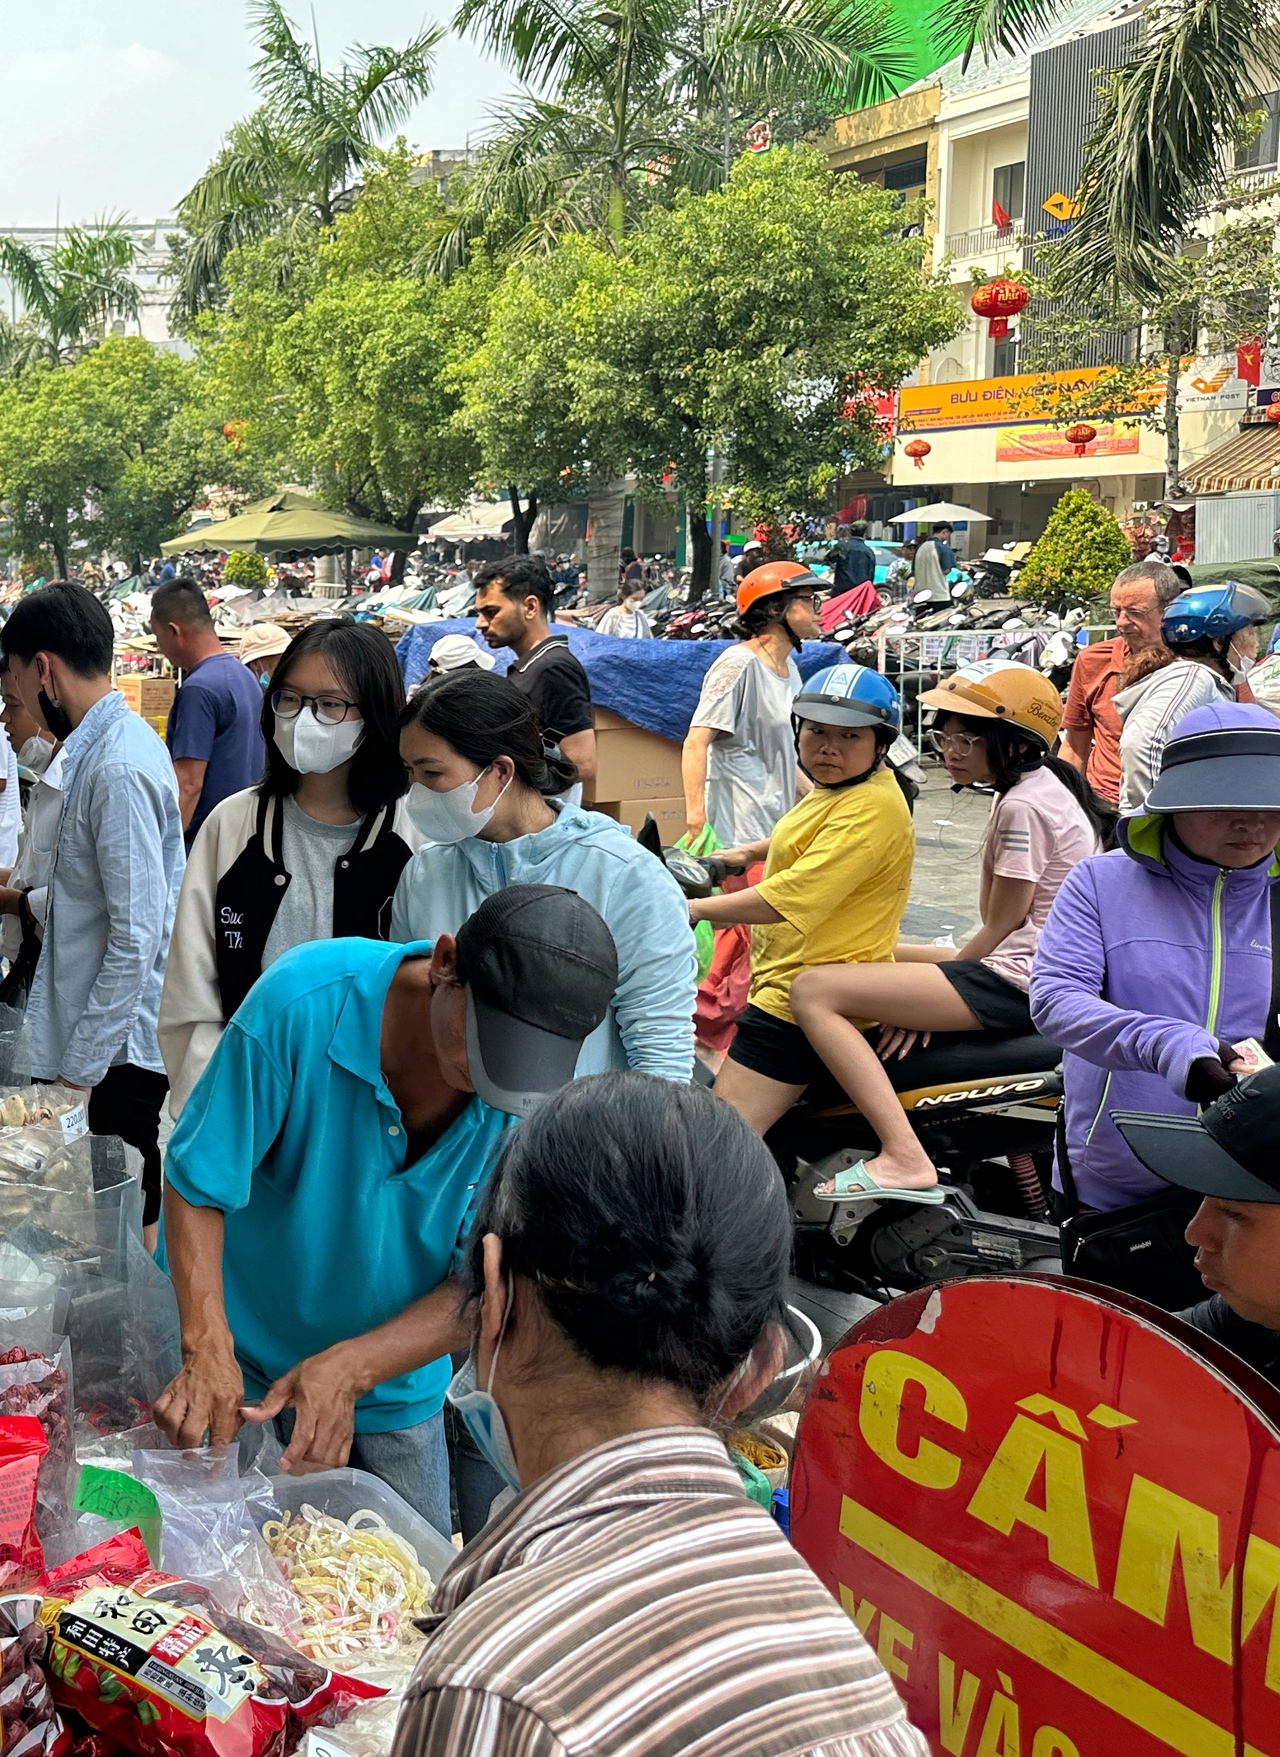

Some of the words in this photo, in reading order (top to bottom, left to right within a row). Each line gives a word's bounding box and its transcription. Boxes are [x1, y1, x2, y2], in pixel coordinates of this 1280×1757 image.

[982, 385, 1015, 403] ĐIỆN
[914, 1079, 1046, 1108] NOUVO
[859, 1349, 1280, 1697] CẤM
[156, 1620, 206, 1659] 精品
[192, 1644, 256, 1697] 枣
